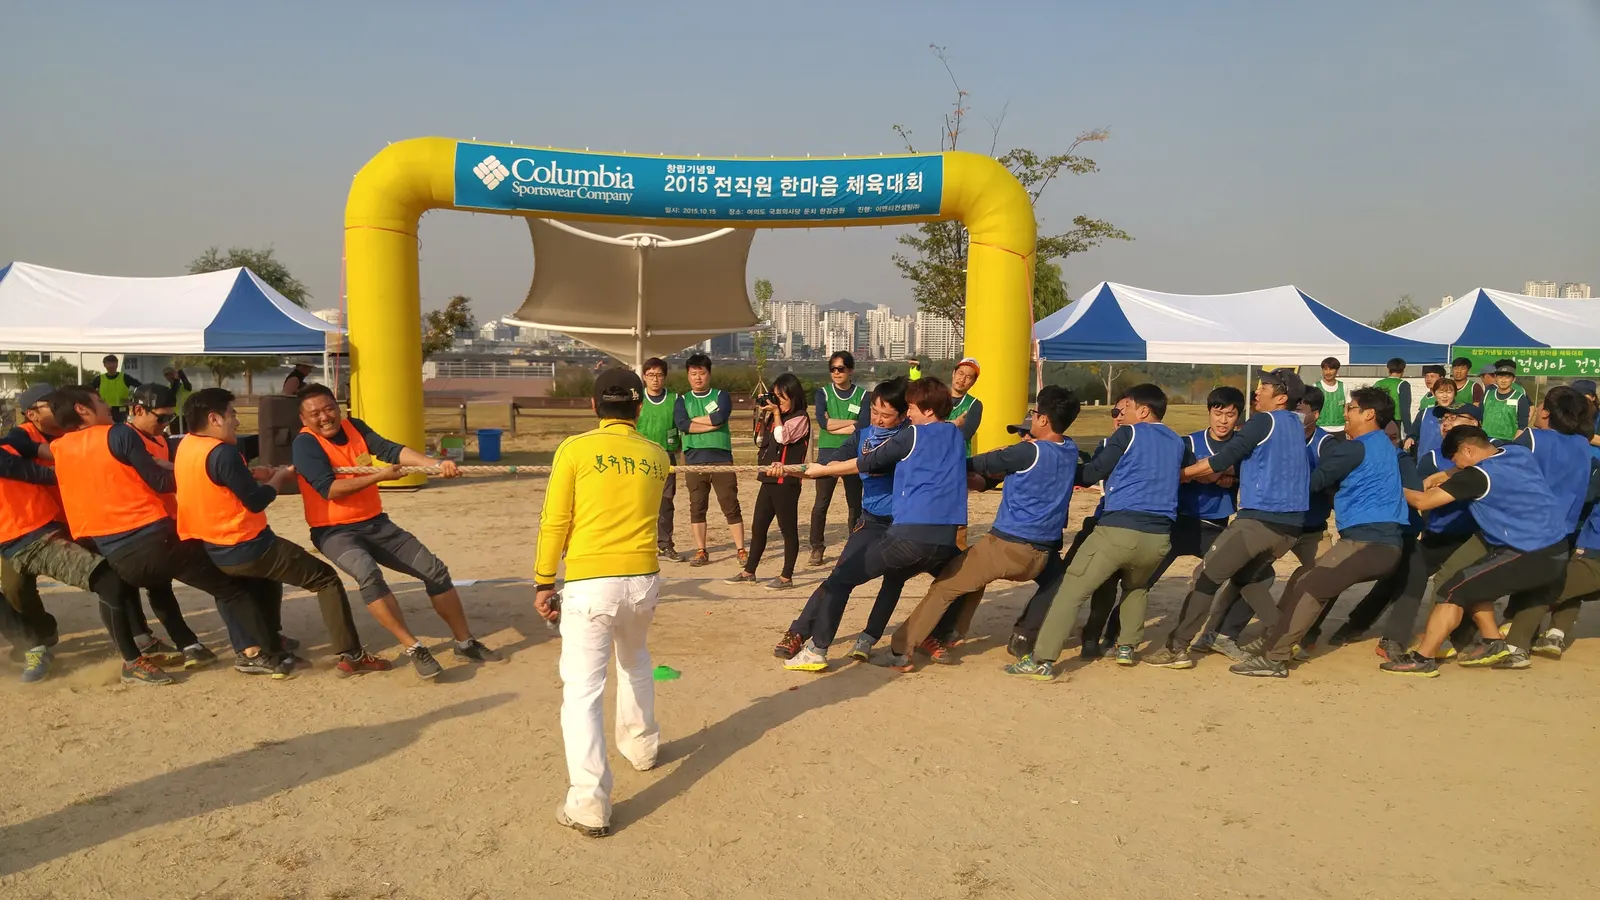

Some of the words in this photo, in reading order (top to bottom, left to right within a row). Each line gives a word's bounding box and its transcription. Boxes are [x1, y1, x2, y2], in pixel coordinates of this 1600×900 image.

[511, 158, 635, 190] Columbia
[666, 164, 716, 174] 창립기념일
[512, 181, 576, 199] Sportswear
[576, 187, 633, 204] Company
[664, 175, 708, 193] 2015
[713, 176, 772, 198] 전직원
[780, 175, 839, 197] 한마음
[845, 171, 923, 195] 체육대회
[728, 208, 744, 216] 장소:
[819, 207, 845, 215] 한강공원
[1511, 356, 1567, 373] 럼비아
